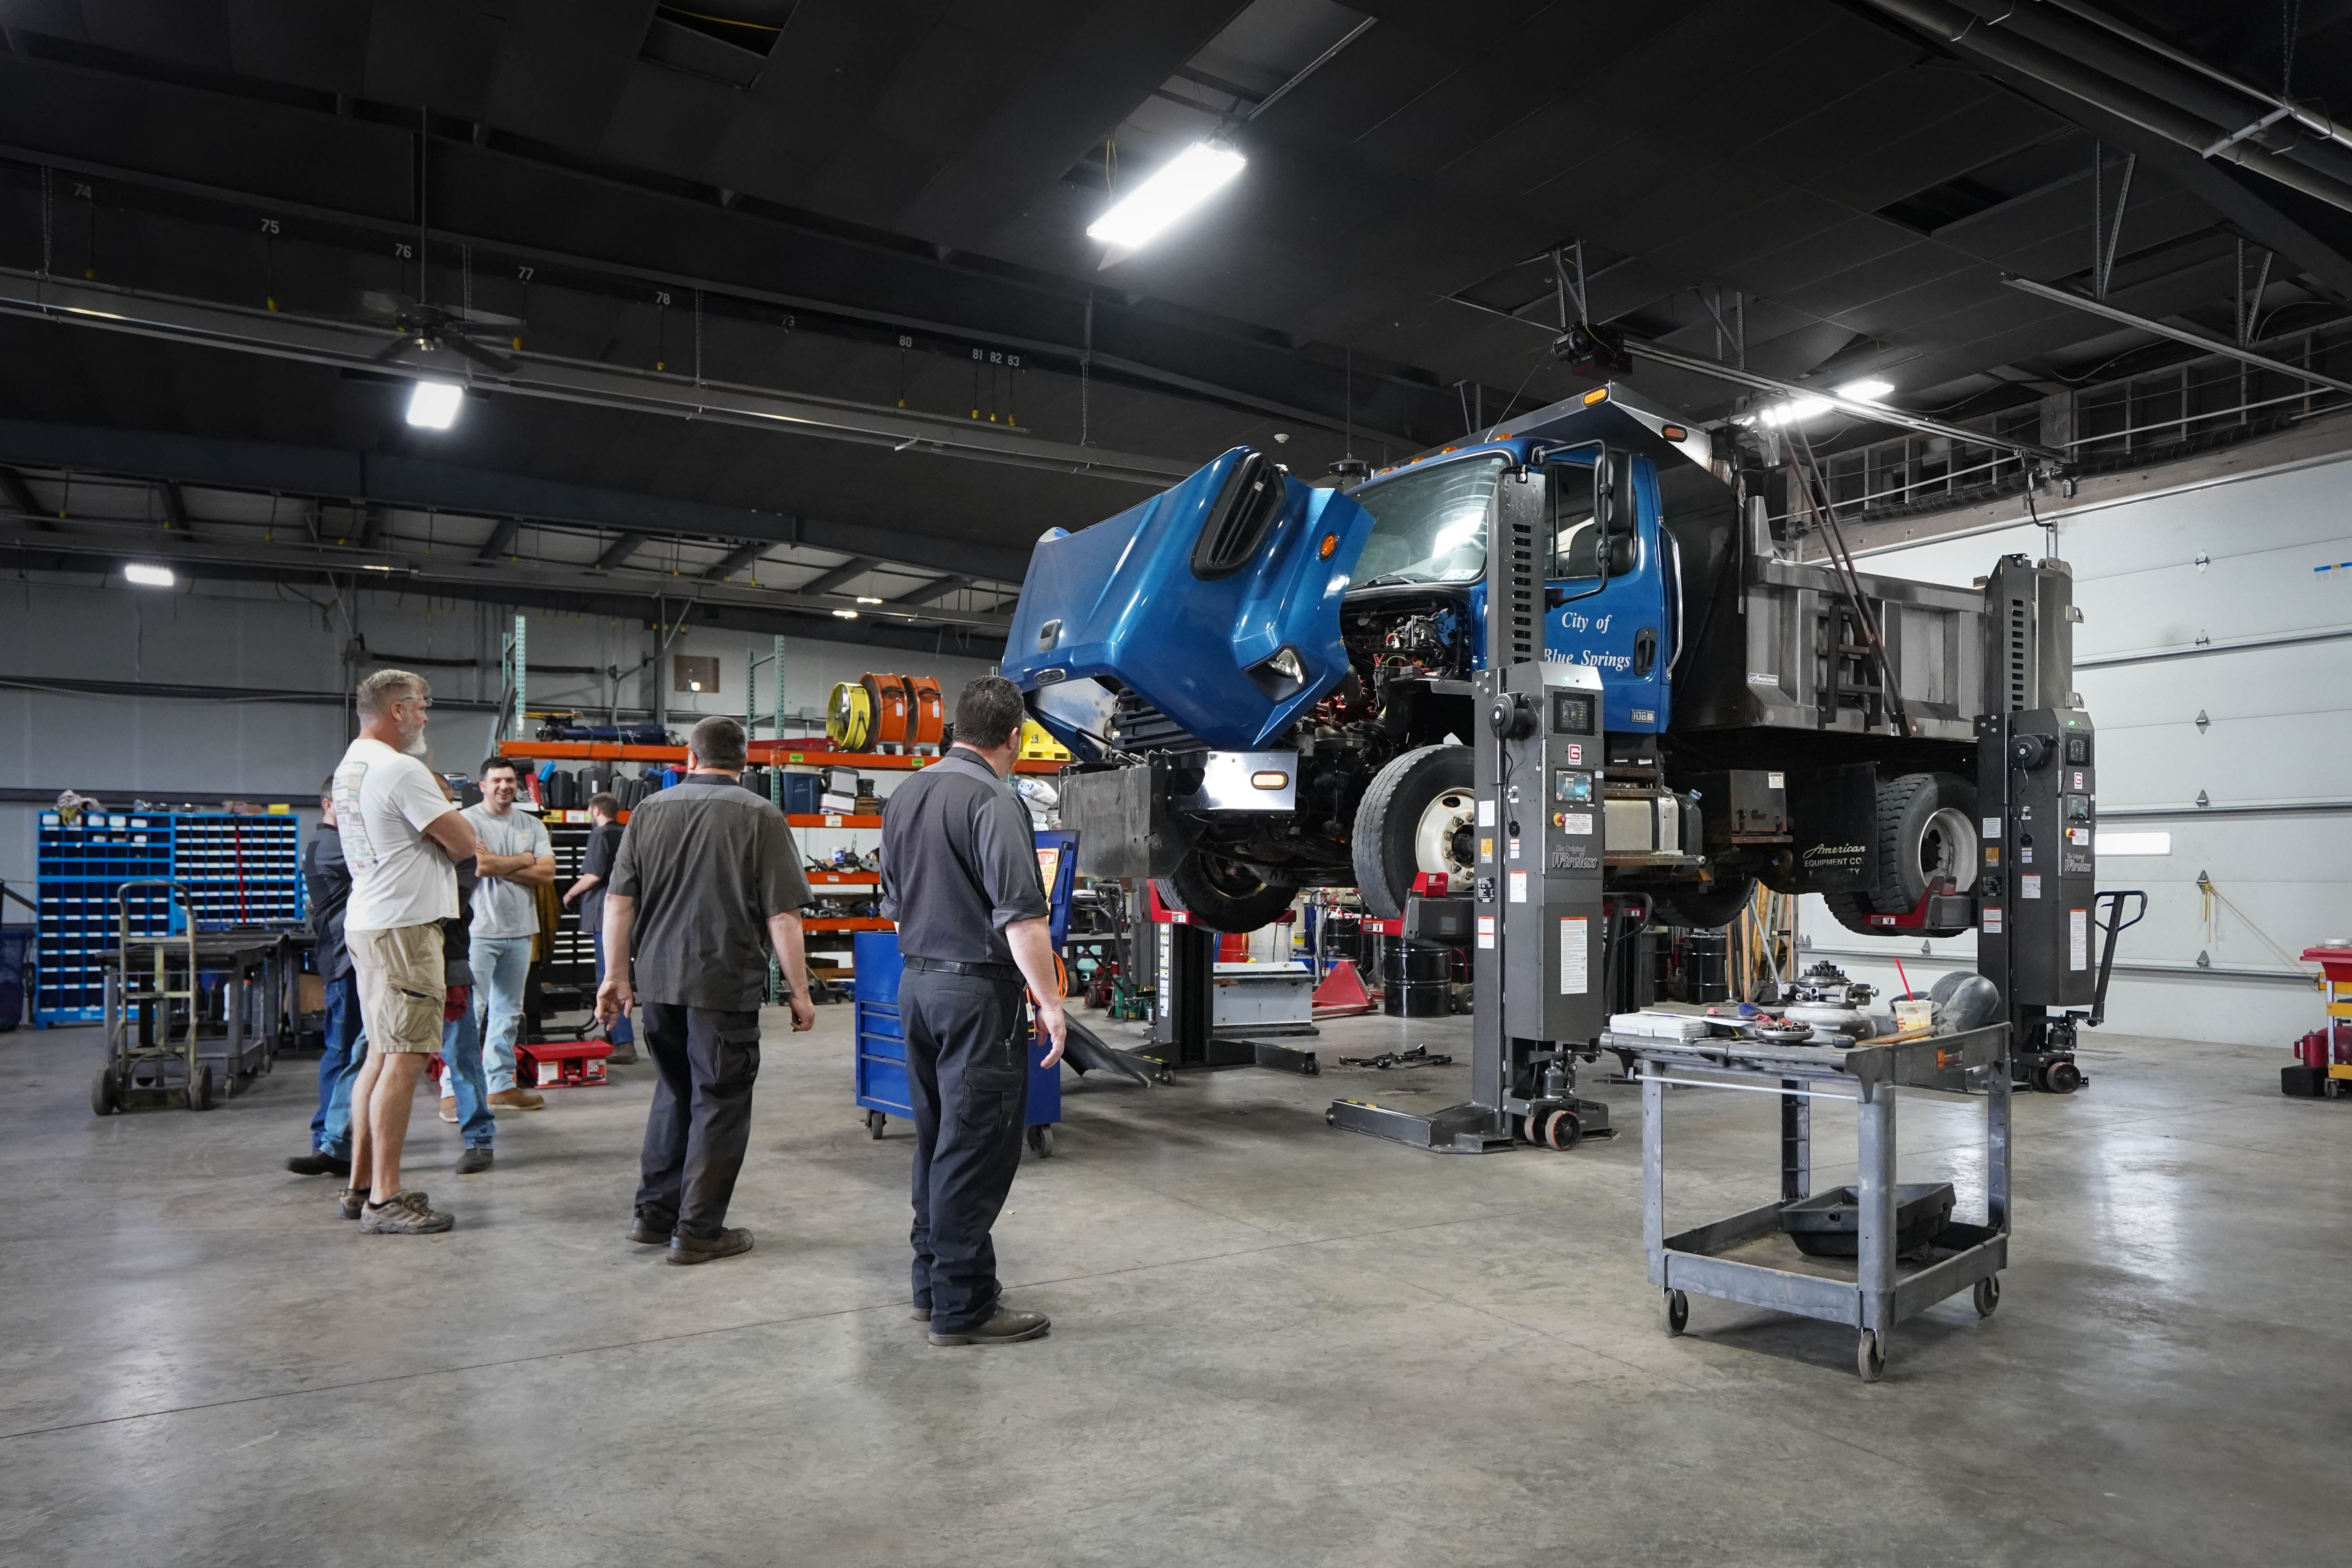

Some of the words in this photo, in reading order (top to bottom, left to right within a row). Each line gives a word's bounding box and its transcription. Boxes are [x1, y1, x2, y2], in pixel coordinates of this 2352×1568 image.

[74, 183, 92, 199] 74
[261, 218, 279, 234] 75
[395, 243, 412, 258] 76
[518, 267, 534, 280] 77
[656, 291, 671, 305] 78
[899, 336, 912, 348] 80
[973, 348, 983, 361] 81
[990, 352, 1002, 364] 82
[1007, 355, 1020, 367] 83
[1562, 612, 1589, 633] City
[1596, 615, 1612, 634] of
[1544, 648, 1574, 664] Blue
[1581, 650, 1631, 671] Springs
[1749, 675, 1777, 683] American
[1564, 844, 1587, 854] Original
[1803, 843, 1866, 859] American
[1038, 853, 1056, 864] UTION
[1552, 851, 1598, 869] Wireless
[1804, 858, 1848, 867] EQUIPMENT
[2064, 859, 2092, 872] Wireless
